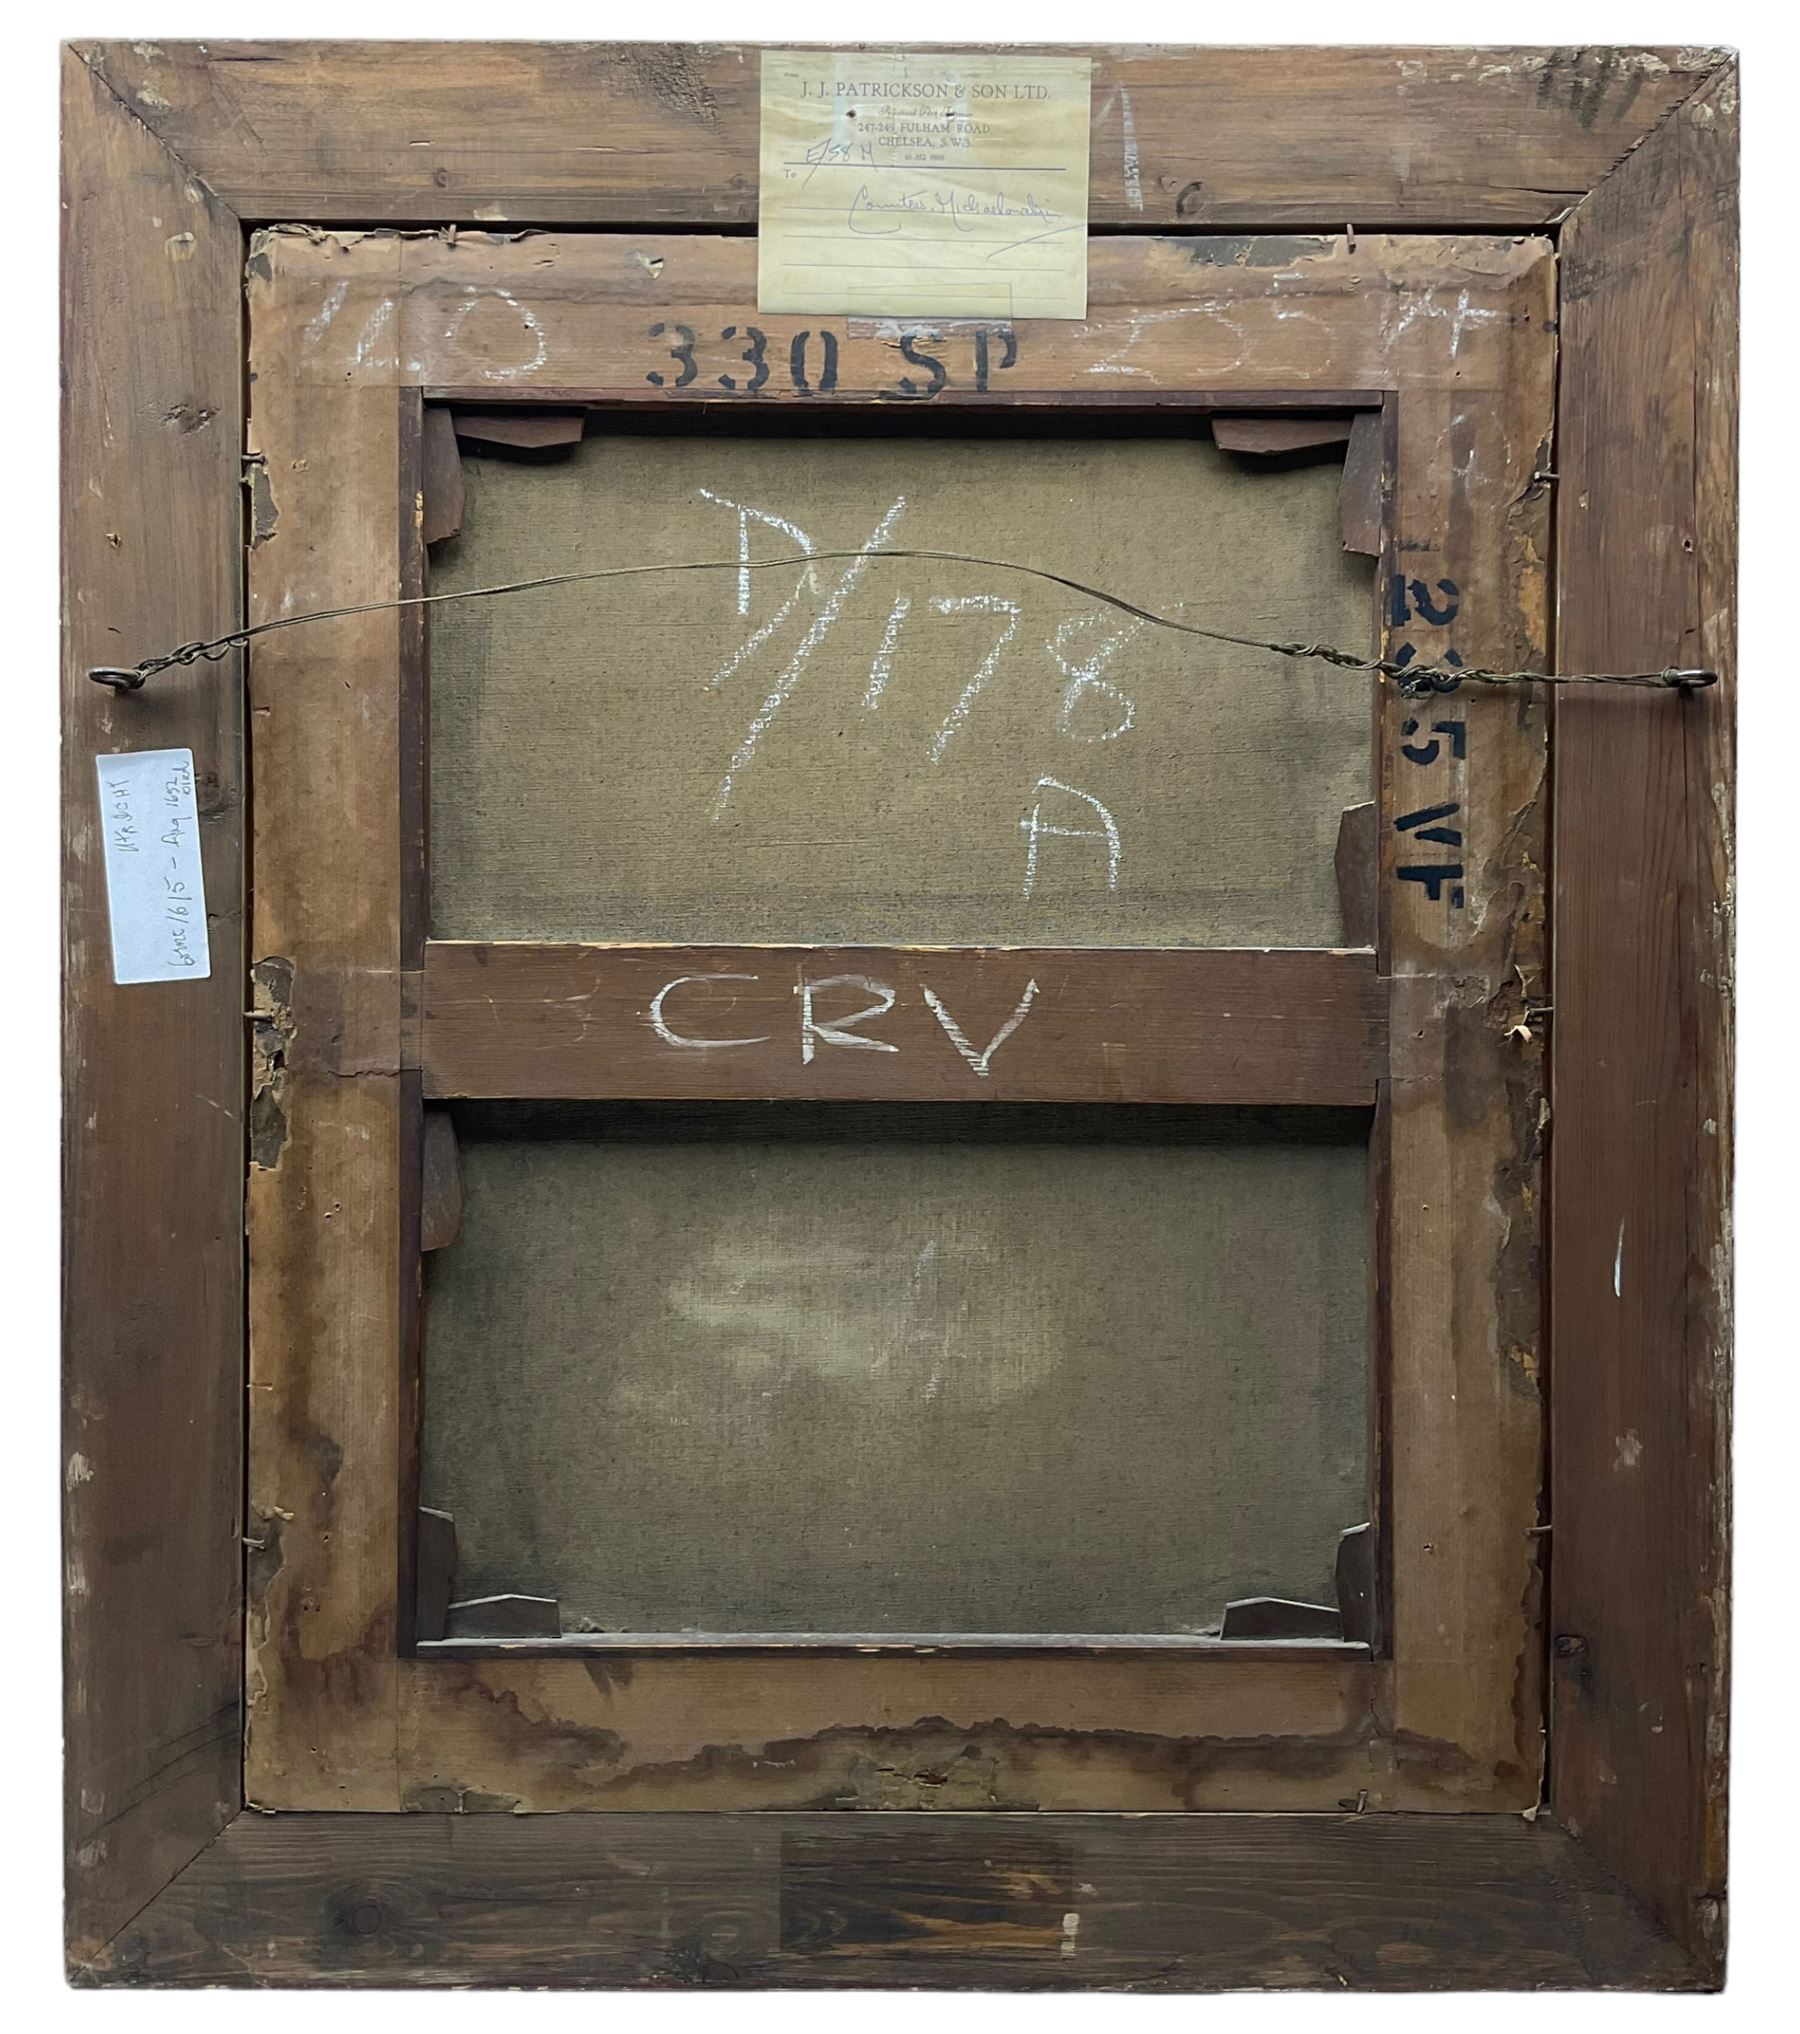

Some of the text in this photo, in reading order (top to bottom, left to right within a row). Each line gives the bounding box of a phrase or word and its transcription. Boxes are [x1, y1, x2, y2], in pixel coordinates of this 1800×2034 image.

[800, 81, 1052, 100] J. J. PATRICKSON & SON LTD.
[878, 136, 936, 148] CHELSEA,
[900, 122, 951, 134] FULHAM
[956, 123, 991, 135] ROAD
[783, 168, 797, 179] To
[646, 322, 1018, 396] 330 SP
[1020, 773, 1121, 899] A
[1394, 802, 1464, 909] VF
[649, 973, 1041, 1077] CRV
